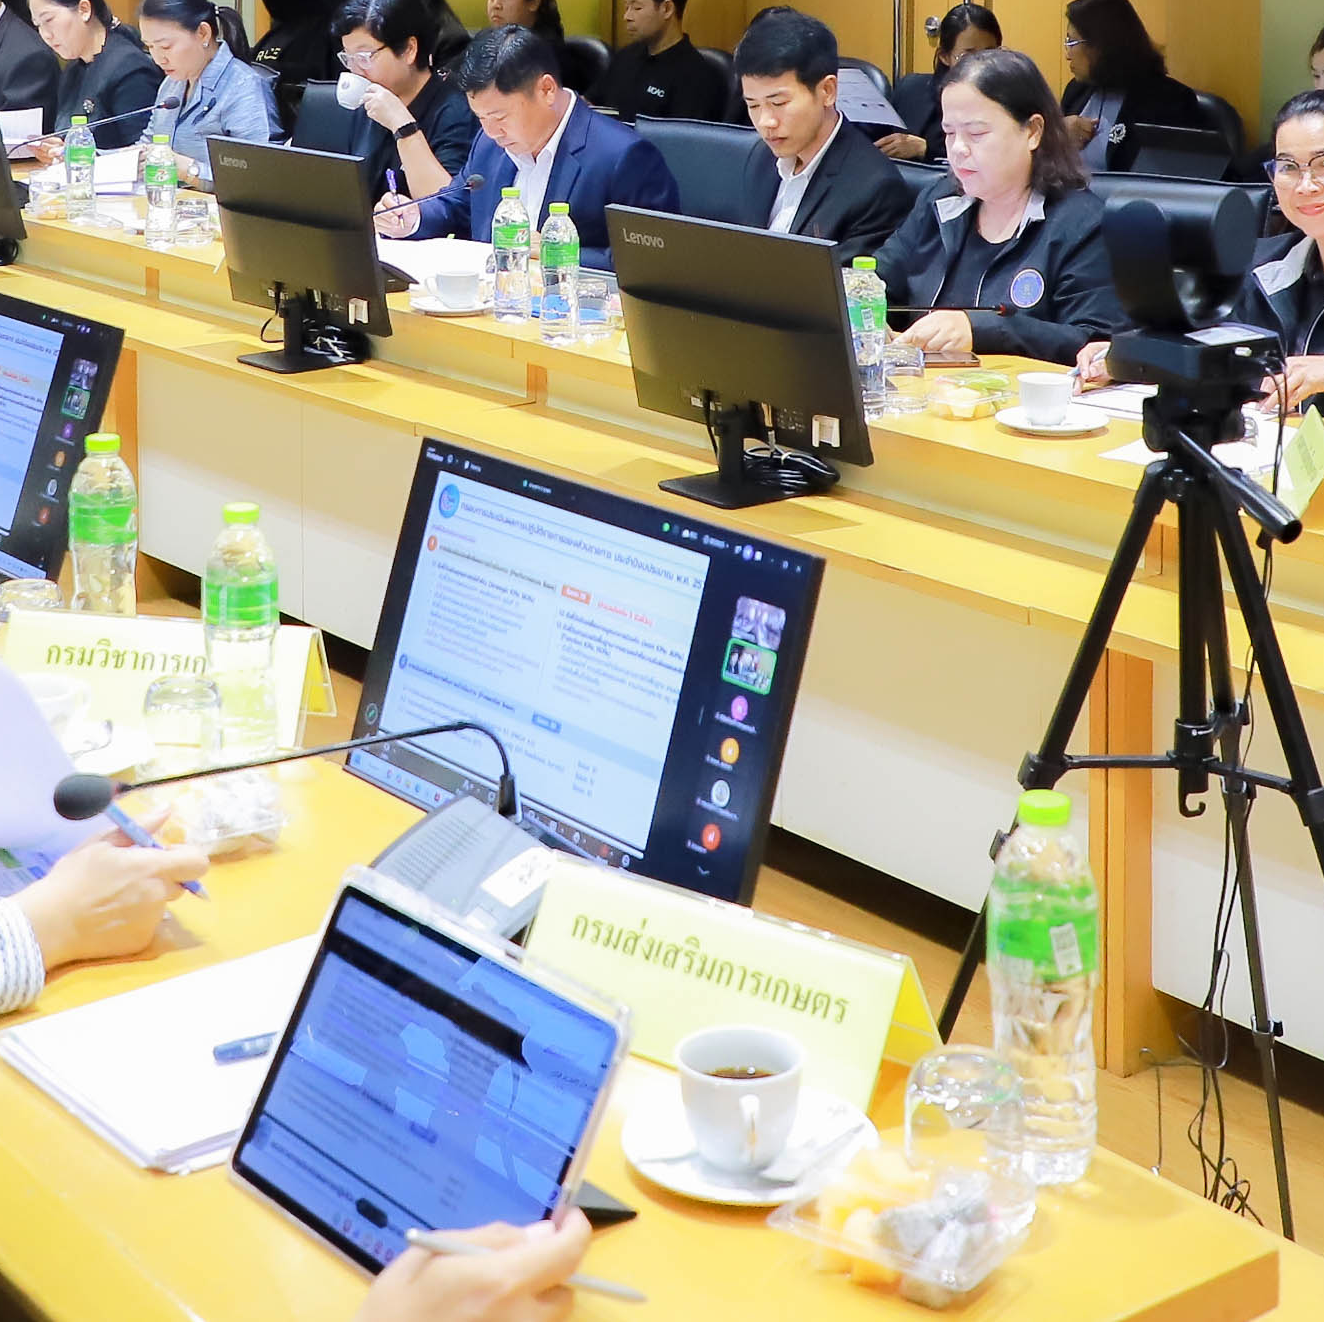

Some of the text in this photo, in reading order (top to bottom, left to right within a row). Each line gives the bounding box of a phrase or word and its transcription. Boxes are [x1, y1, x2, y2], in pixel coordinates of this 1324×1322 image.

[218, 153, 249, 170] Lenovo
[621, 227, 665, 249] Lenovo
[45, 637, 208, 677] กรมวิชาการเก
[570, 913, 851, 1024] กรมส่งเสริมการเกษตร
